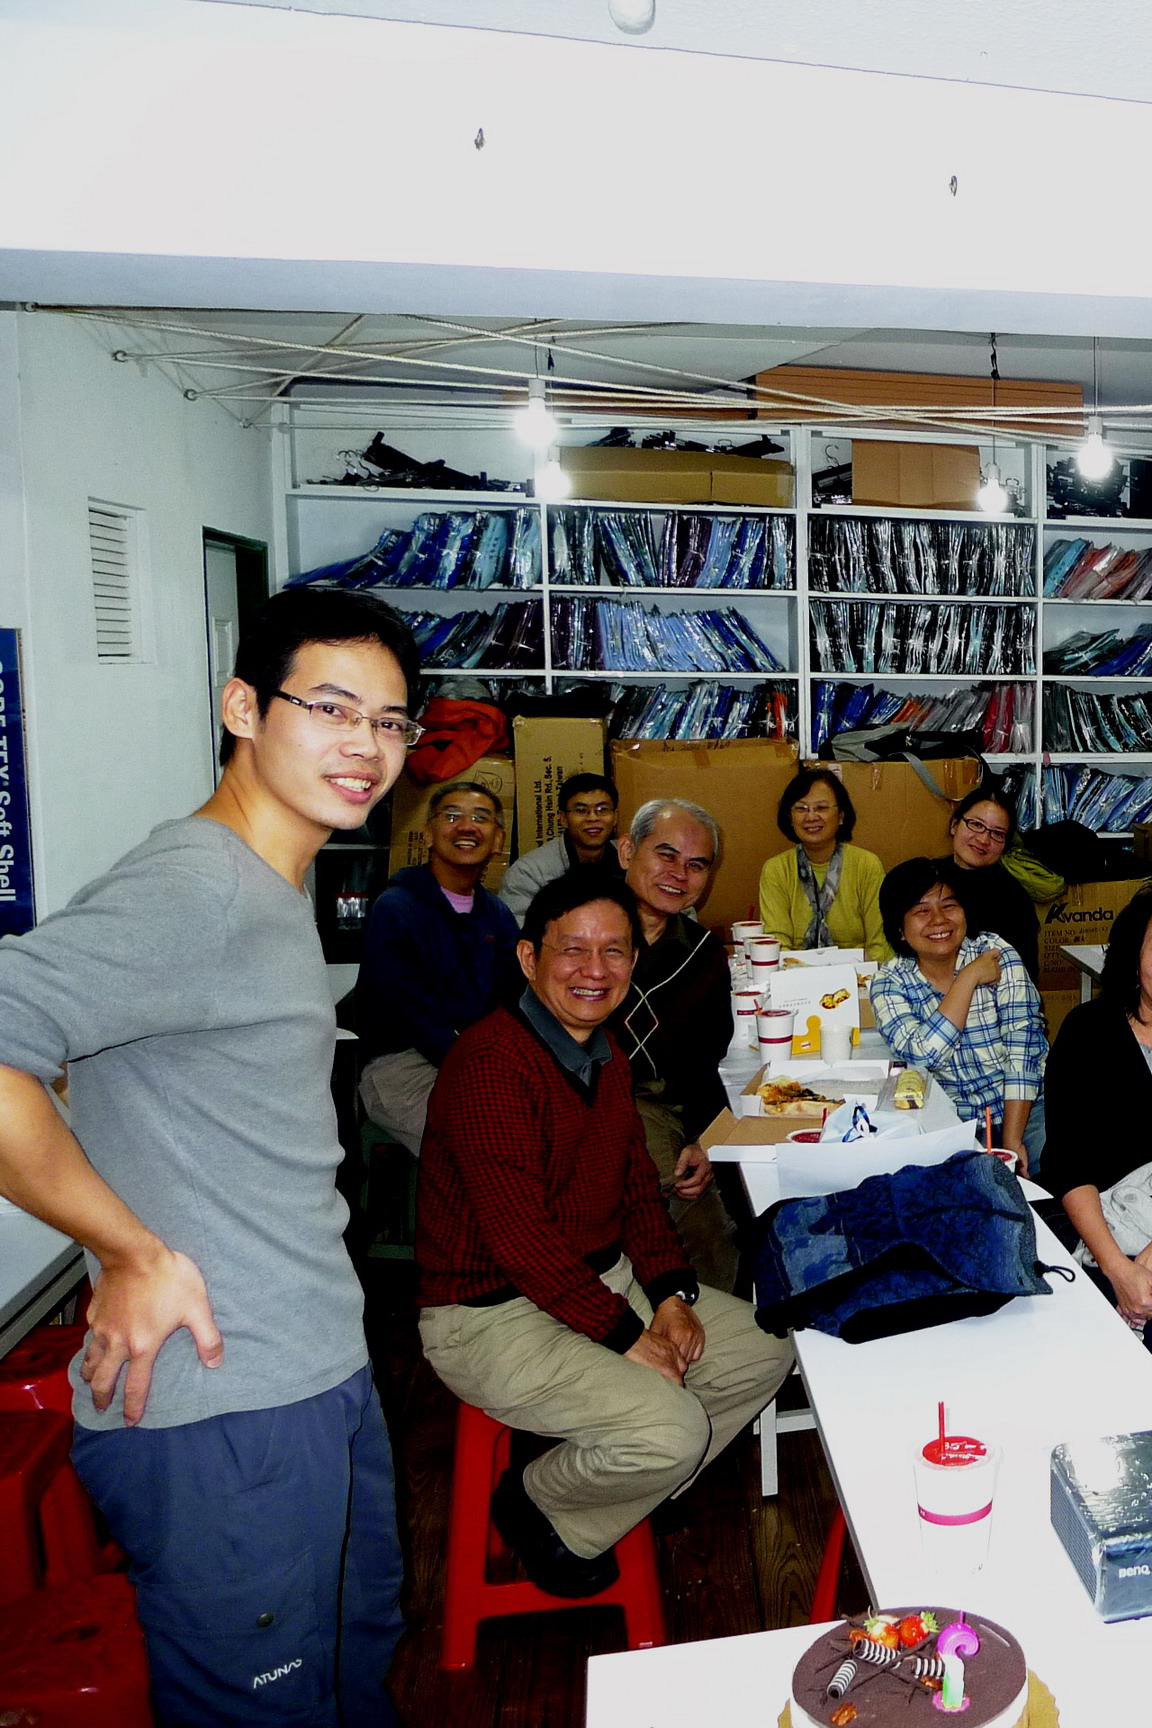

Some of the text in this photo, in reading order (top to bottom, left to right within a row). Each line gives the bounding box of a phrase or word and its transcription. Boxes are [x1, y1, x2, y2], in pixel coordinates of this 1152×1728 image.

[0, 791, 12, 836] Soft
[545, 794, 553, 812] Hsin
[0, 844, 16, 902] Shell
[1118, 1565, 1151, 1578] BenQ
